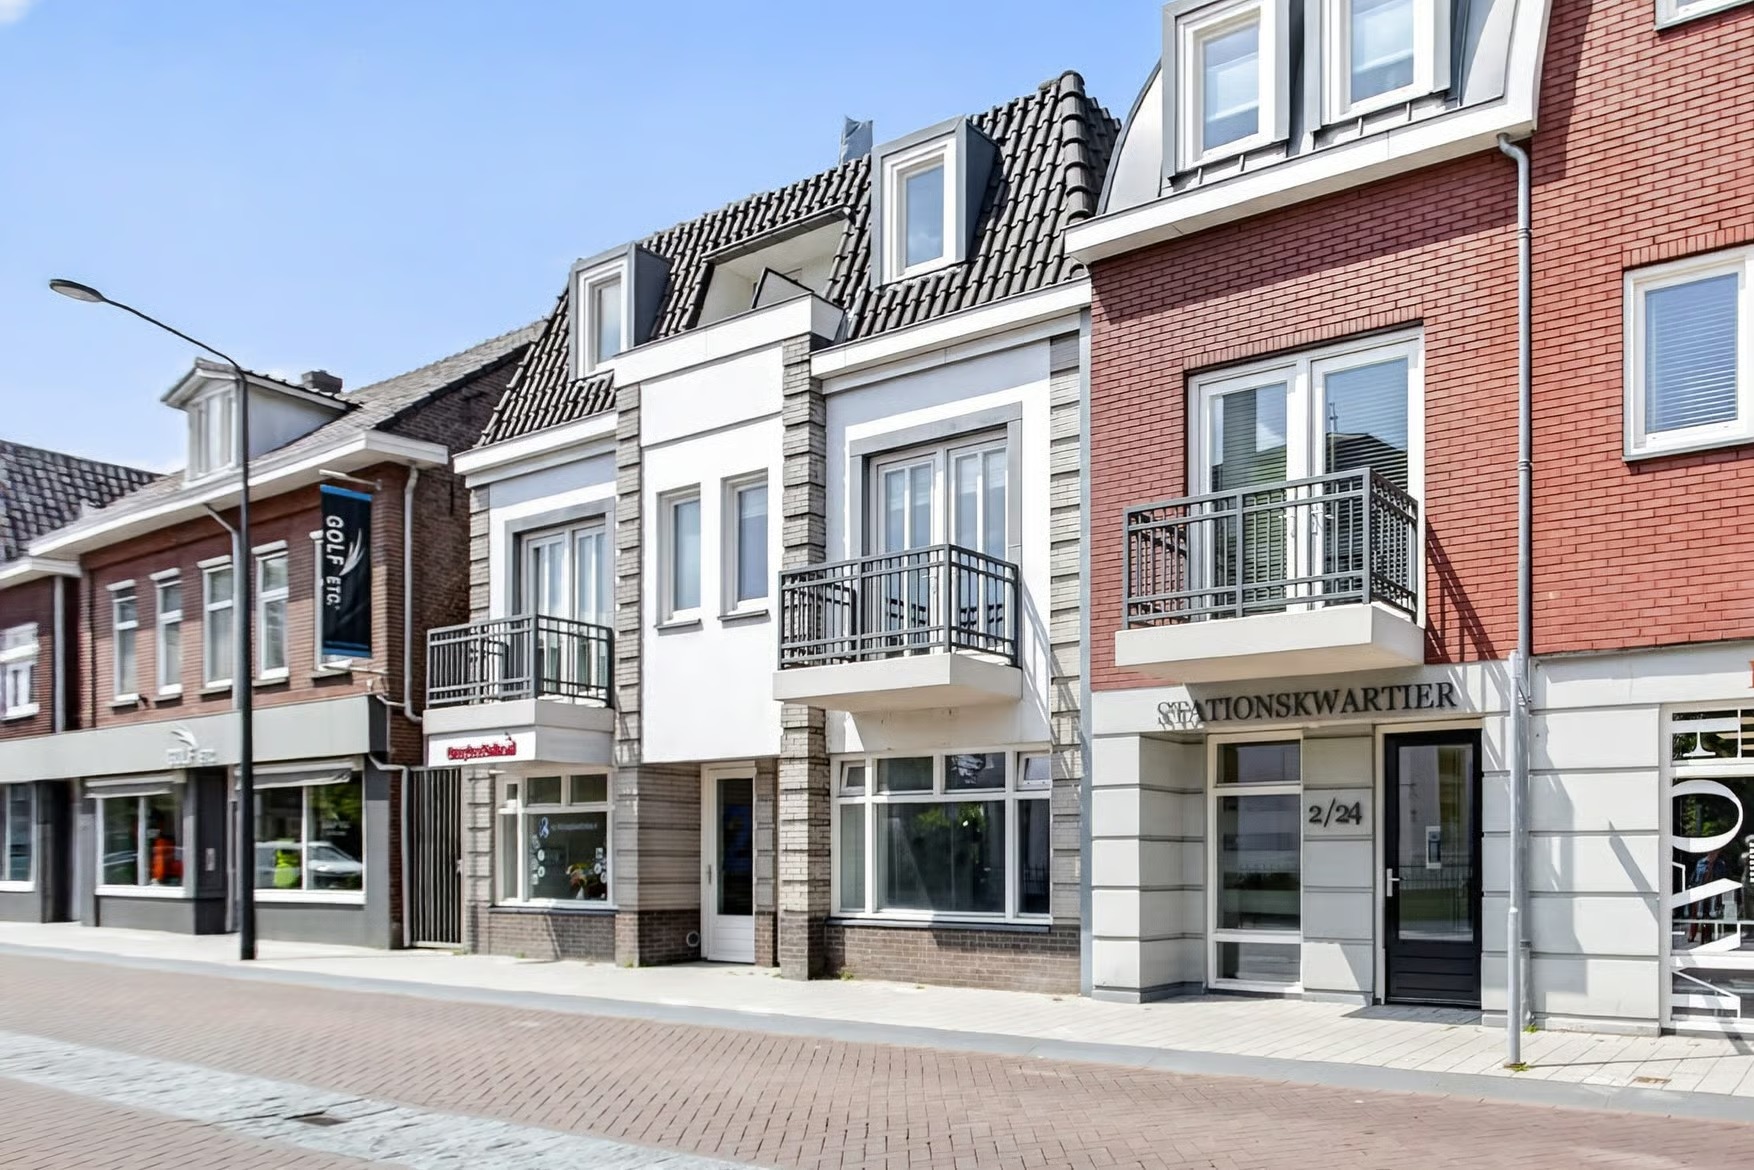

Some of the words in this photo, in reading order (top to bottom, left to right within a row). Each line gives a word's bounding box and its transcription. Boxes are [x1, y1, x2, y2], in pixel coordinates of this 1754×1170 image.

[326, 515, 345, 566] GOLF
[1157, 681, 1458, 723] STATIONSKWARTIER
[1308, 797, 1363, 828] 2/24
